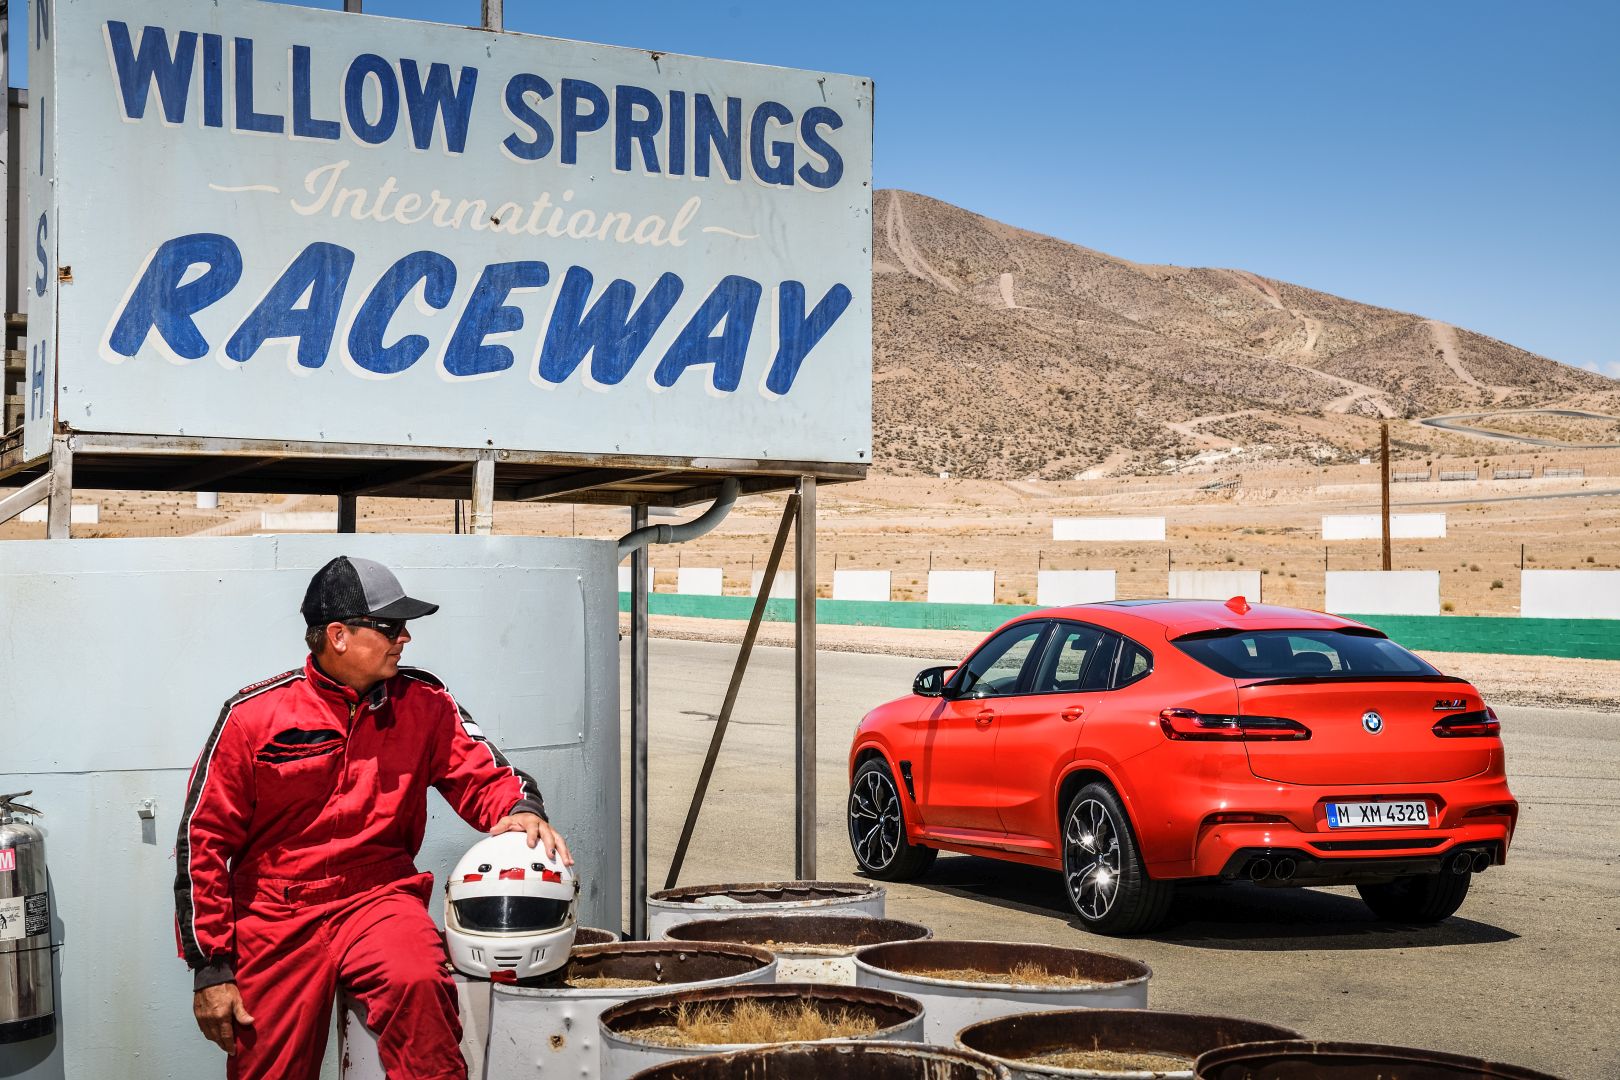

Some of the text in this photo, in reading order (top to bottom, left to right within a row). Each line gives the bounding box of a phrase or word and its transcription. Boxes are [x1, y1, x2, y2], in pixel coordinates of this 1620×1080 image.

[106, 21, 844, 190] WILLOW SPRINGS
[290, 159, 702, 247] International
[104, 232, 852, 396] RACEWAY
[1337, 804, 1426, 824] M XM 4328
